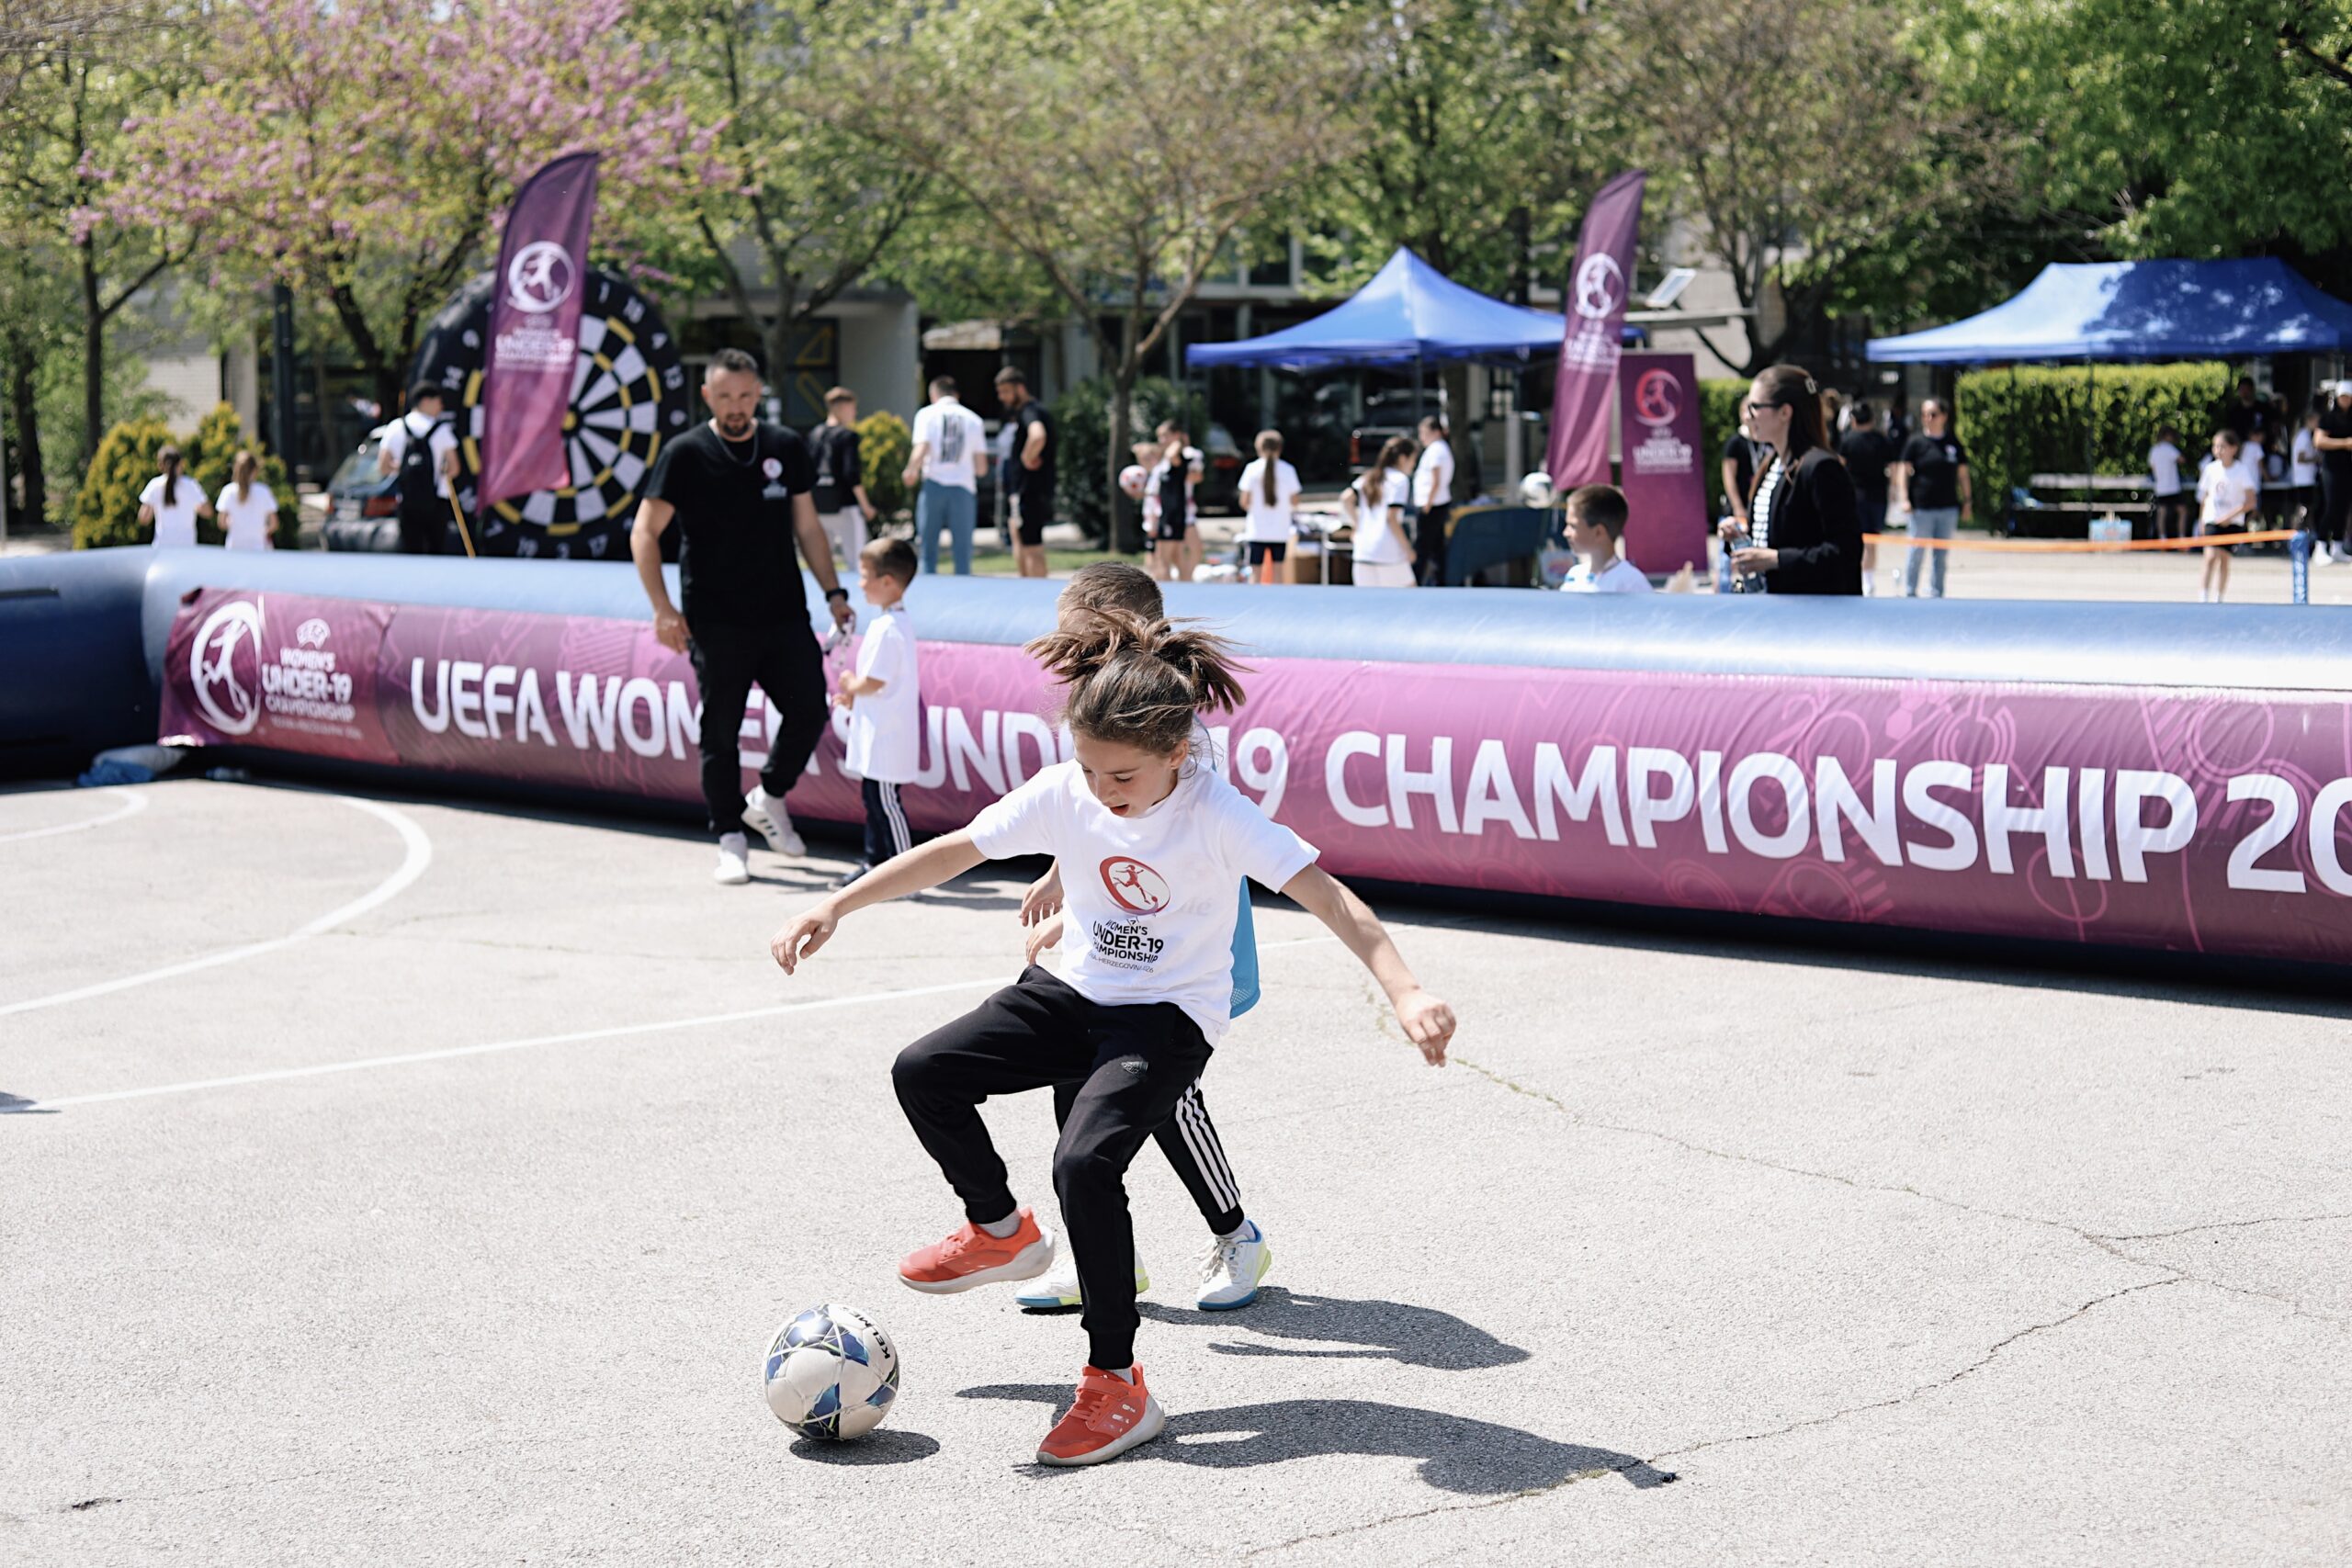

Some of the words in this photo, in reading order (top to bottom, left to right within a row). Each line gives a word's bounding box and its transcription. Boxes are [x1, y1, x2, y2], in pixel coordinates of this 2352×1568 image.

[261, 662, 353, 705] UNDER-19
[411, 657, 558, 747] UEFA
[914, 705, 1289, 819] UND19
[1324, 730, 2199, 884] CHAMPIONSHIP
[1092, 920, 1165, 954] UNDER-19
[1093, 937, 1159, 964] MPIONSHIP
